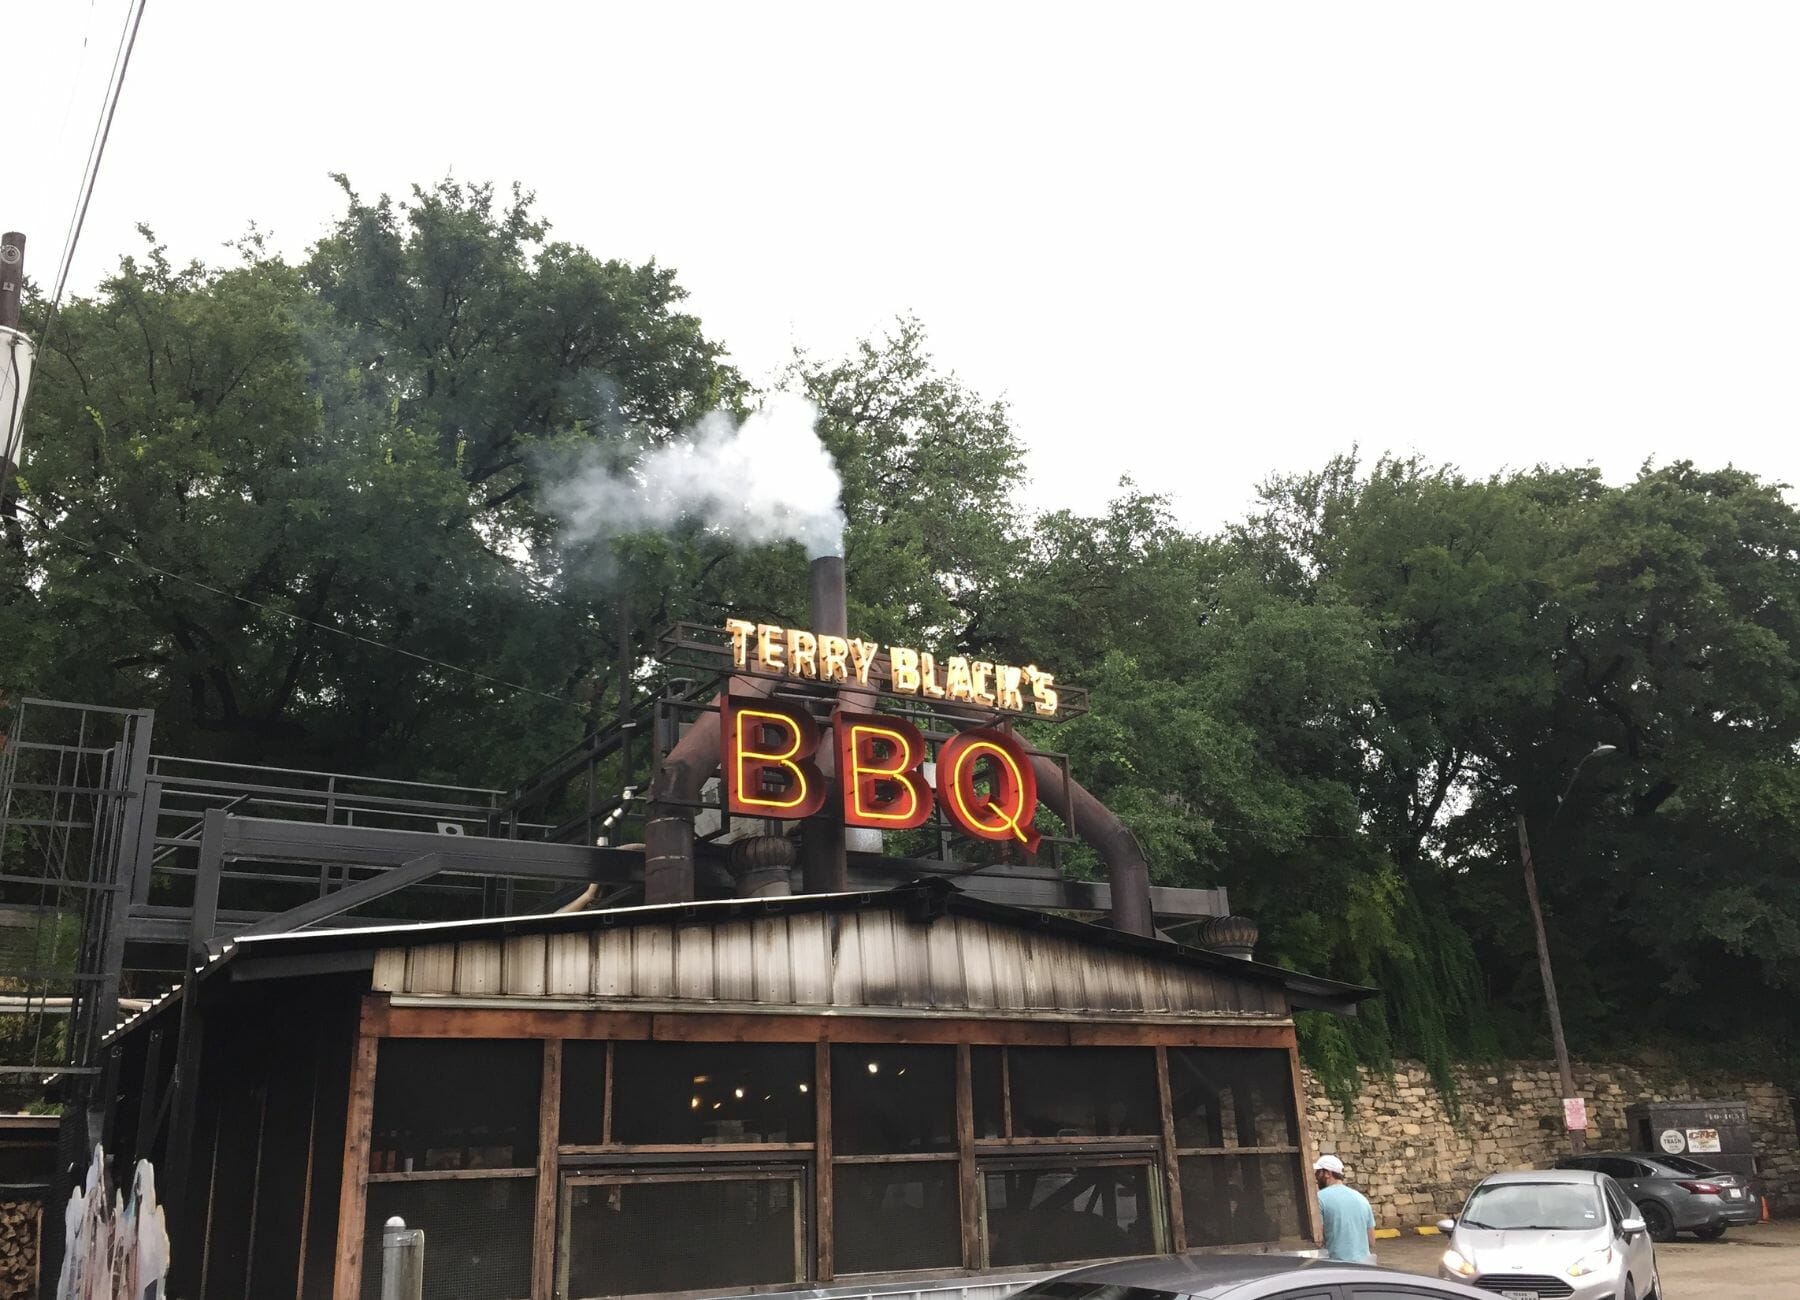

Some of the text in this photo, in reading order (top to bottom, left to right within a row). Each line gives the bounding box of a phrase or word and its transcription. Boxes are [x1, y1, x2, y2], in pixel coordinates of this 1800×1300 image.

[725, 618, 1059, 715] TERRY BLACK'S
[720, 694, 1042, 854] BBQ
